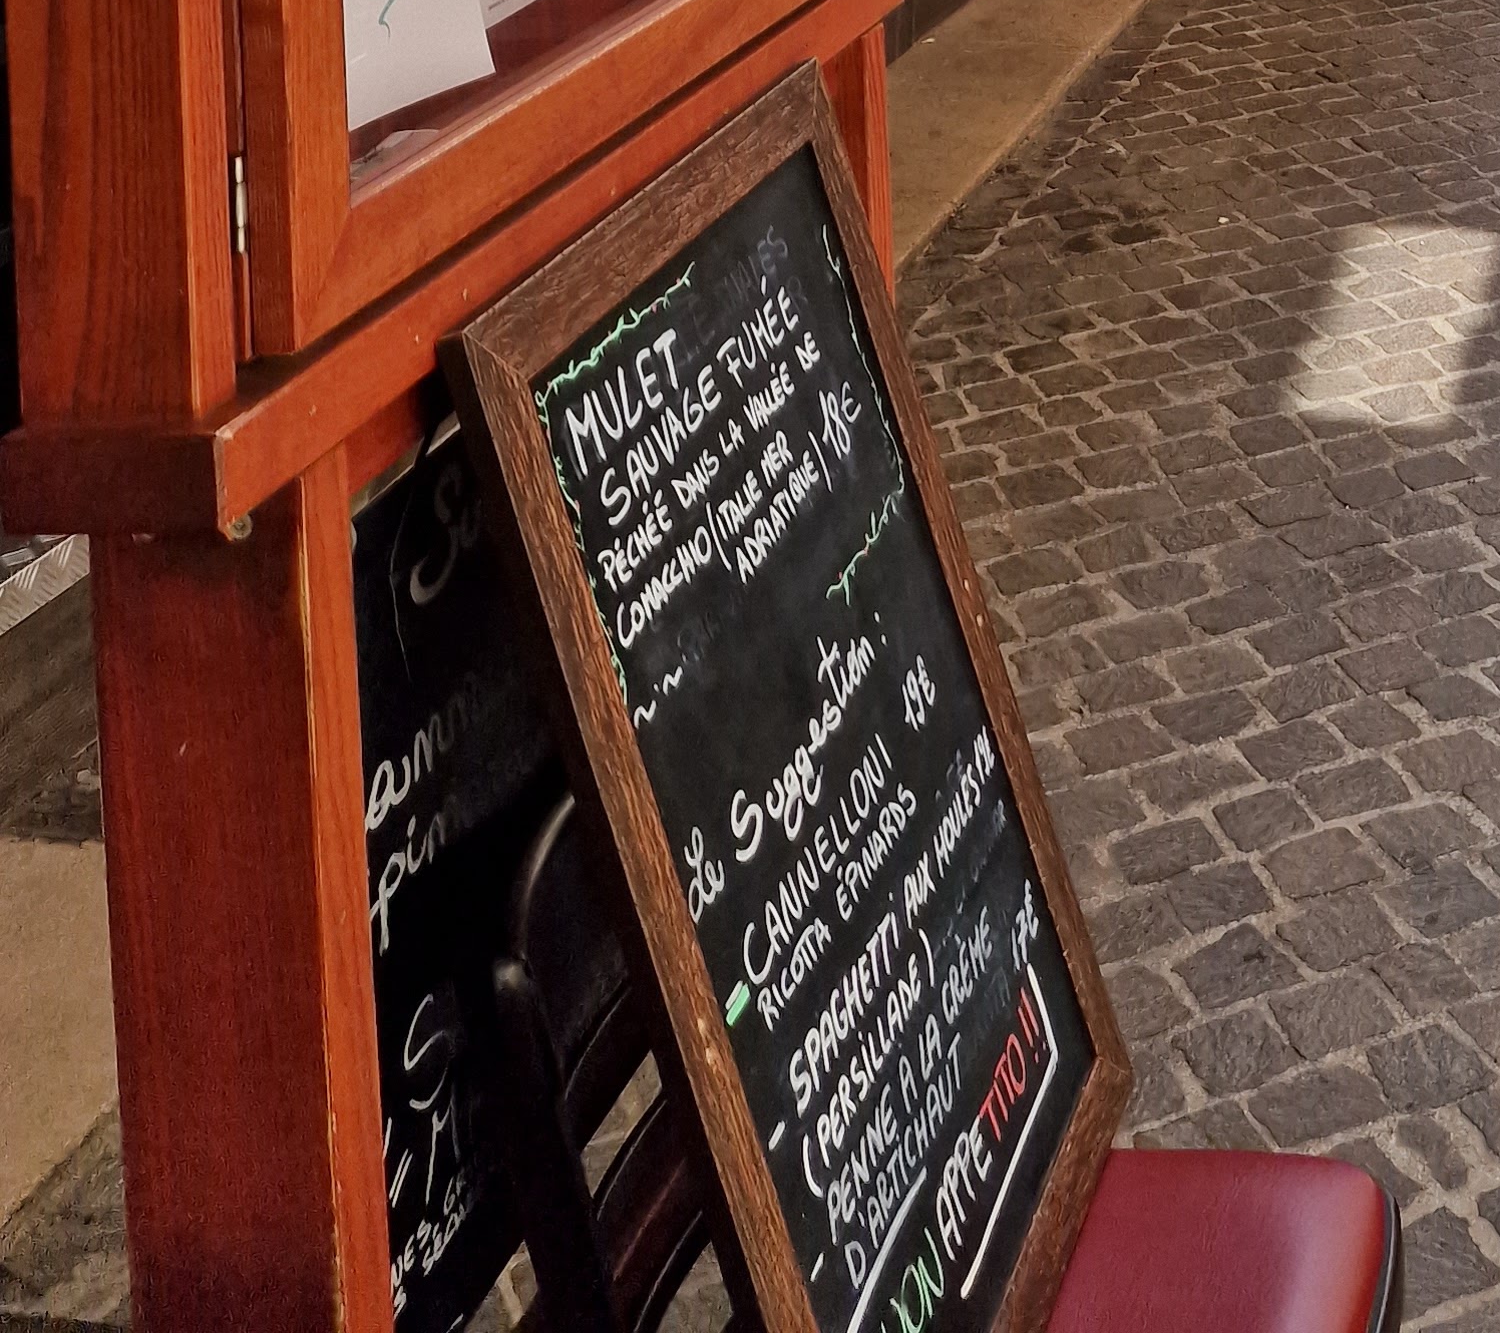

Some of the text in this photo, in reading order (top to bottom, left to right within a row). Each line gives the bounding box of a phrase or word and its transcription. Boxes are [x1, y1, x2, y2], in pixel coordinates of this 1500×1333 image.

[565, 328, 681, 477] MULET
[600, 275, 800, 527] SAUVAGE FUMÉE
[671, 448, 720, 510] DANS
[718, 418, 746, 458] LA
[742, 360, 796, 433] VALLÉE
[795, 331, 822, 373] DE
[760, 430, 795, 489] MER
[821, 381, 862, 461] 18€
[742, 732, 894, 986] CANNELLONI
[756, 782, 918, 1032] RICOTTA ÉPINARDS
[790, 890, 900, 1119] SPAGHETTI
[903, 850, 938, 930] AUX
[932, 761, 983, 880] MOULES
[826, 1081, 901, 1247] PENNE
[898, 1054, 919, 1115] A
[918, 1013, 943, 1082] LA
